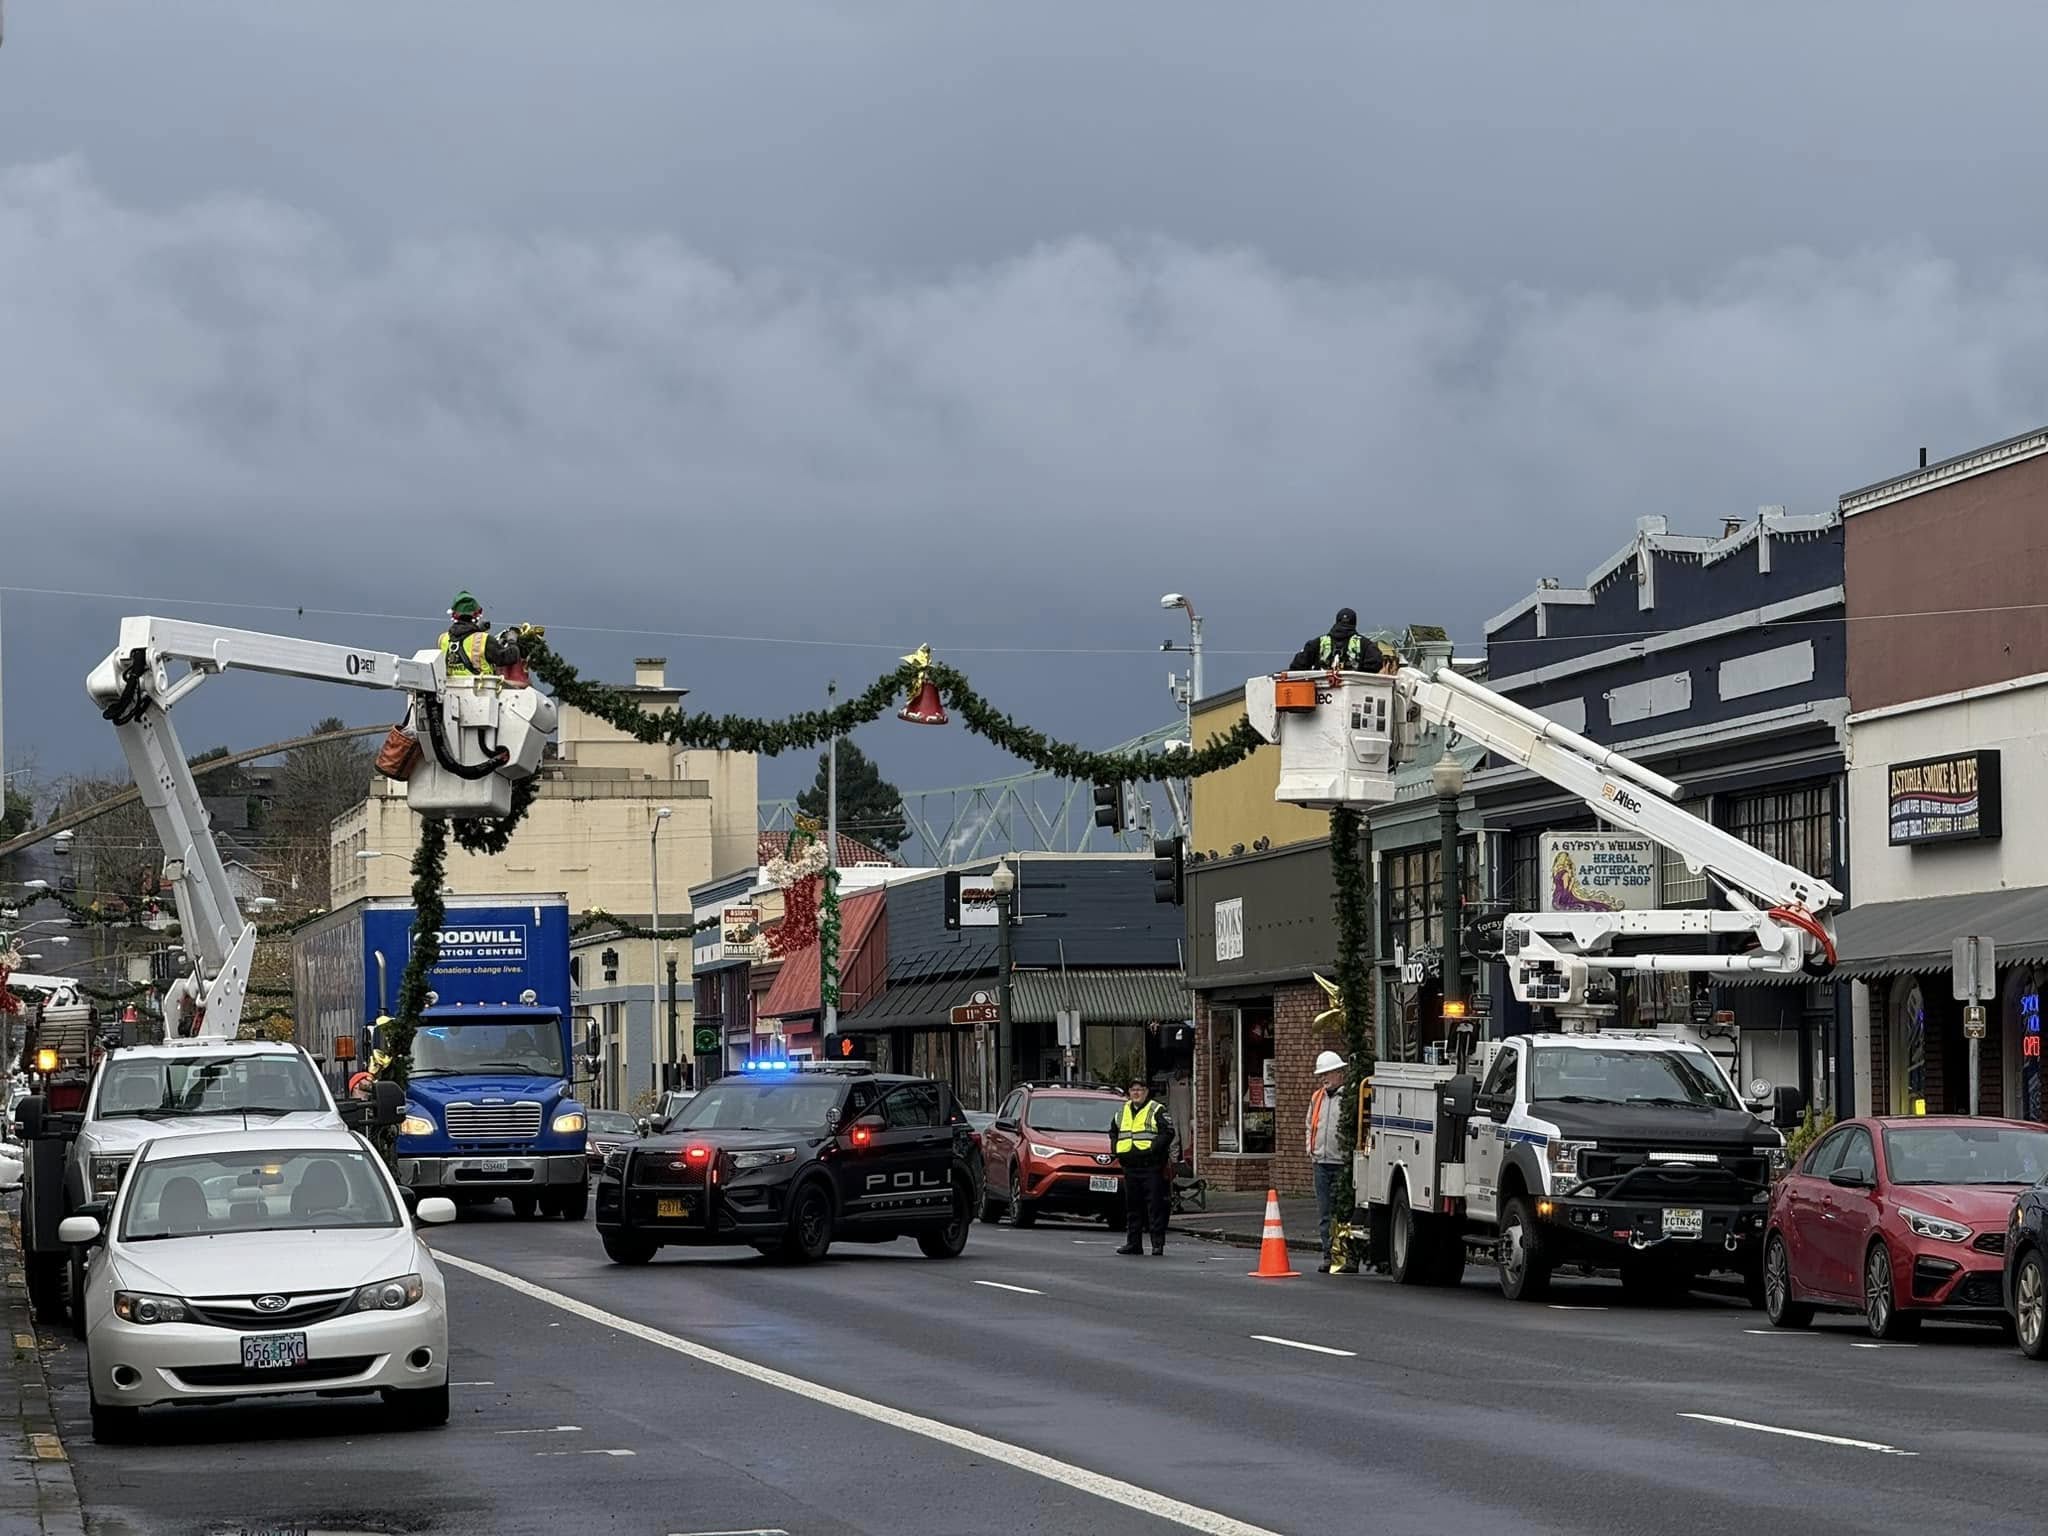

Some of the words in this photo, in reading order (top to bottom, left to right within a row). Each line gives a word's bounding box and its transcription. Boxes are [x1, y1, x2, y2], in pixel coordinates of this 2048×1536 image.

[1891, 768, 1922, 798] ASTORIA
[1923, 763, 1949, 793] SMOKE
[1950, 761, 1957, 794] &
[1957, 758, 1978, 793] VAPE
[1613, 789, 1642, 813] Altec
[1927, 817, 1952, 834] CIGARETTES
[1552, 841, 1559, 851] A
[1608, 839, 1652, 851] WHIMSY
[1593, 853, 1638, 864] HERBAL
[1579, 864, 1654, 875] APOTHECARY
[1581, 876, 1590, 886] &
[1593, 876, 1620, 886] GIFT
[1622, 876, 1651, 886] SHOP
[1217, 906, 1241, 936] BOOKS
[413, 931, 522, 944] OODWILL
[477, 947, 522, 956] CENTER
[725, 945, 754, 955] MARKE
[433, 966, 471, 975] donations
[473, 965, 501, 975] change
[503, 965, 523, 974] lives.
[985, 1008, 998, 1018] St
[871, 1200, 903, 1208] CITY
[245, 1343, 270, 1361] 656
[279, 1341, 304, 1360] PKC
